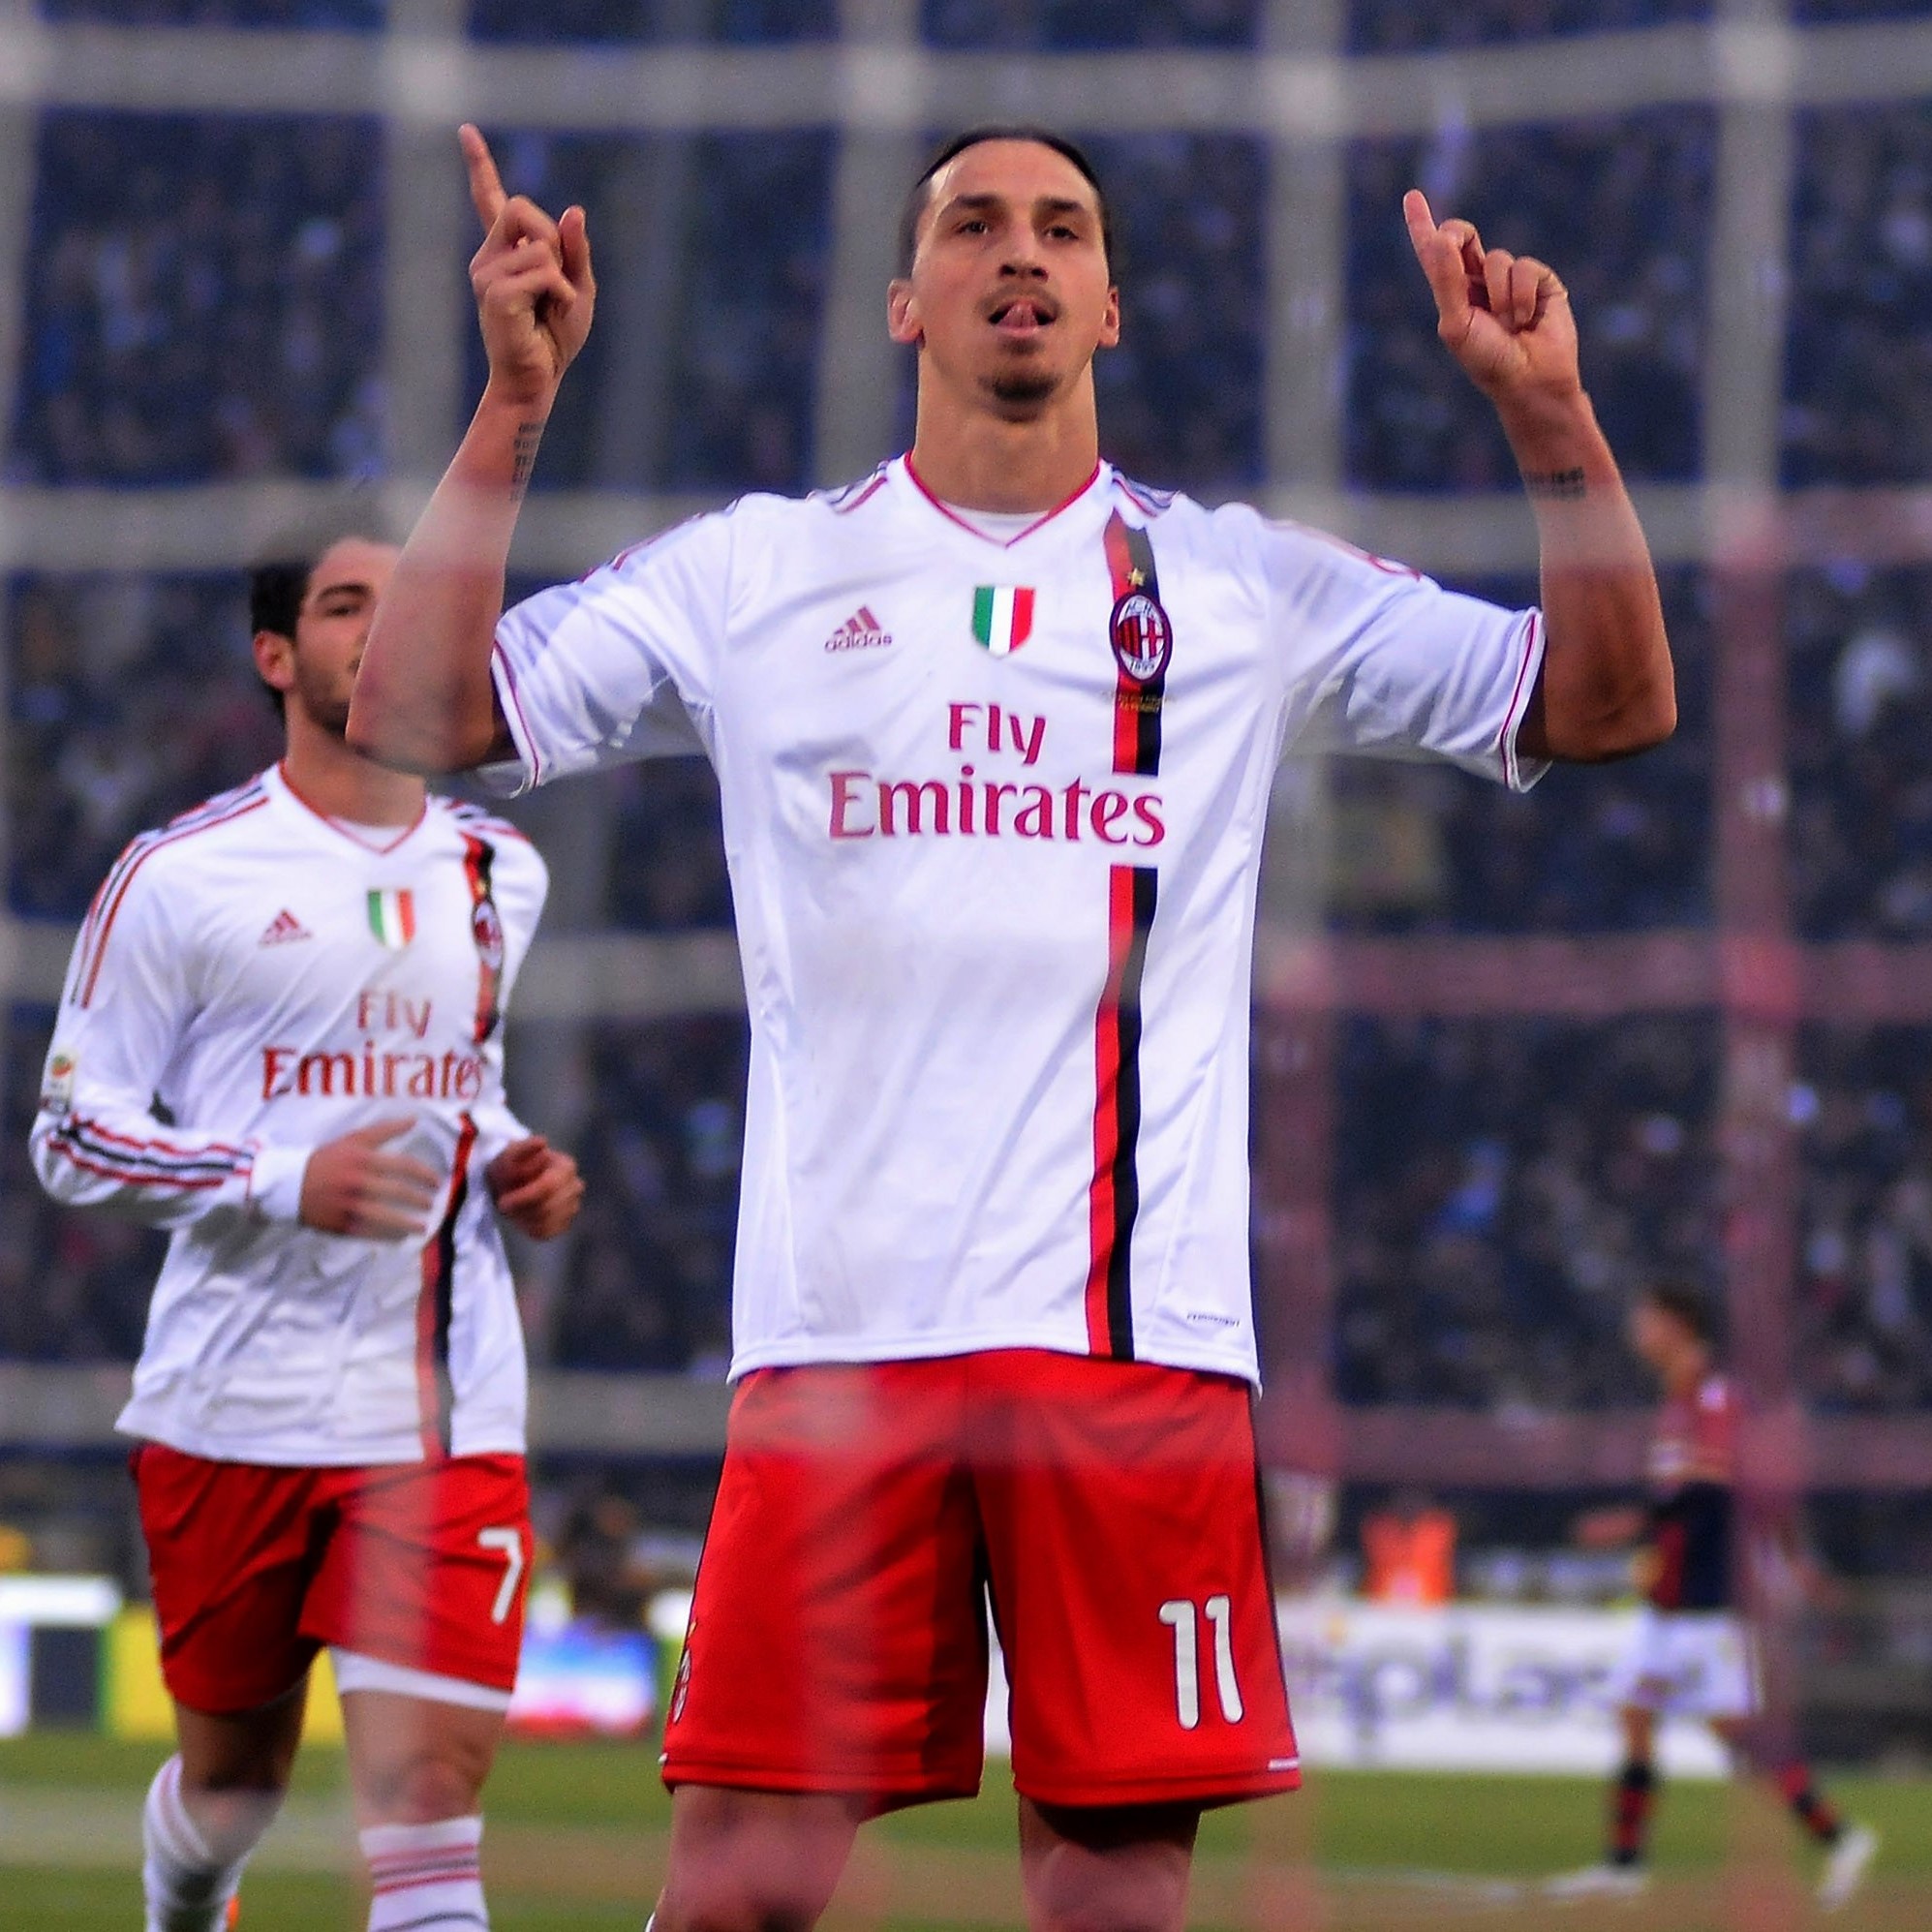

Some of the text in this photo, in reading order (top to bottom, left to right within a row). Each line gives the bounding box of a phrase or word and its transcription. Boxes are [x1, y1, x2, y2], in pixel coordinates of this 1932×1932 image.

[824, 630, 893, 653] adidas
[948, 702, 1046, 765] Fly
[828, 765, 1166, 846] Emirates
[358, 989, 432, 1038] Fly
[478, 1528, 523, 1624] 7
[1159, 1596, 1243, 1729] 11
